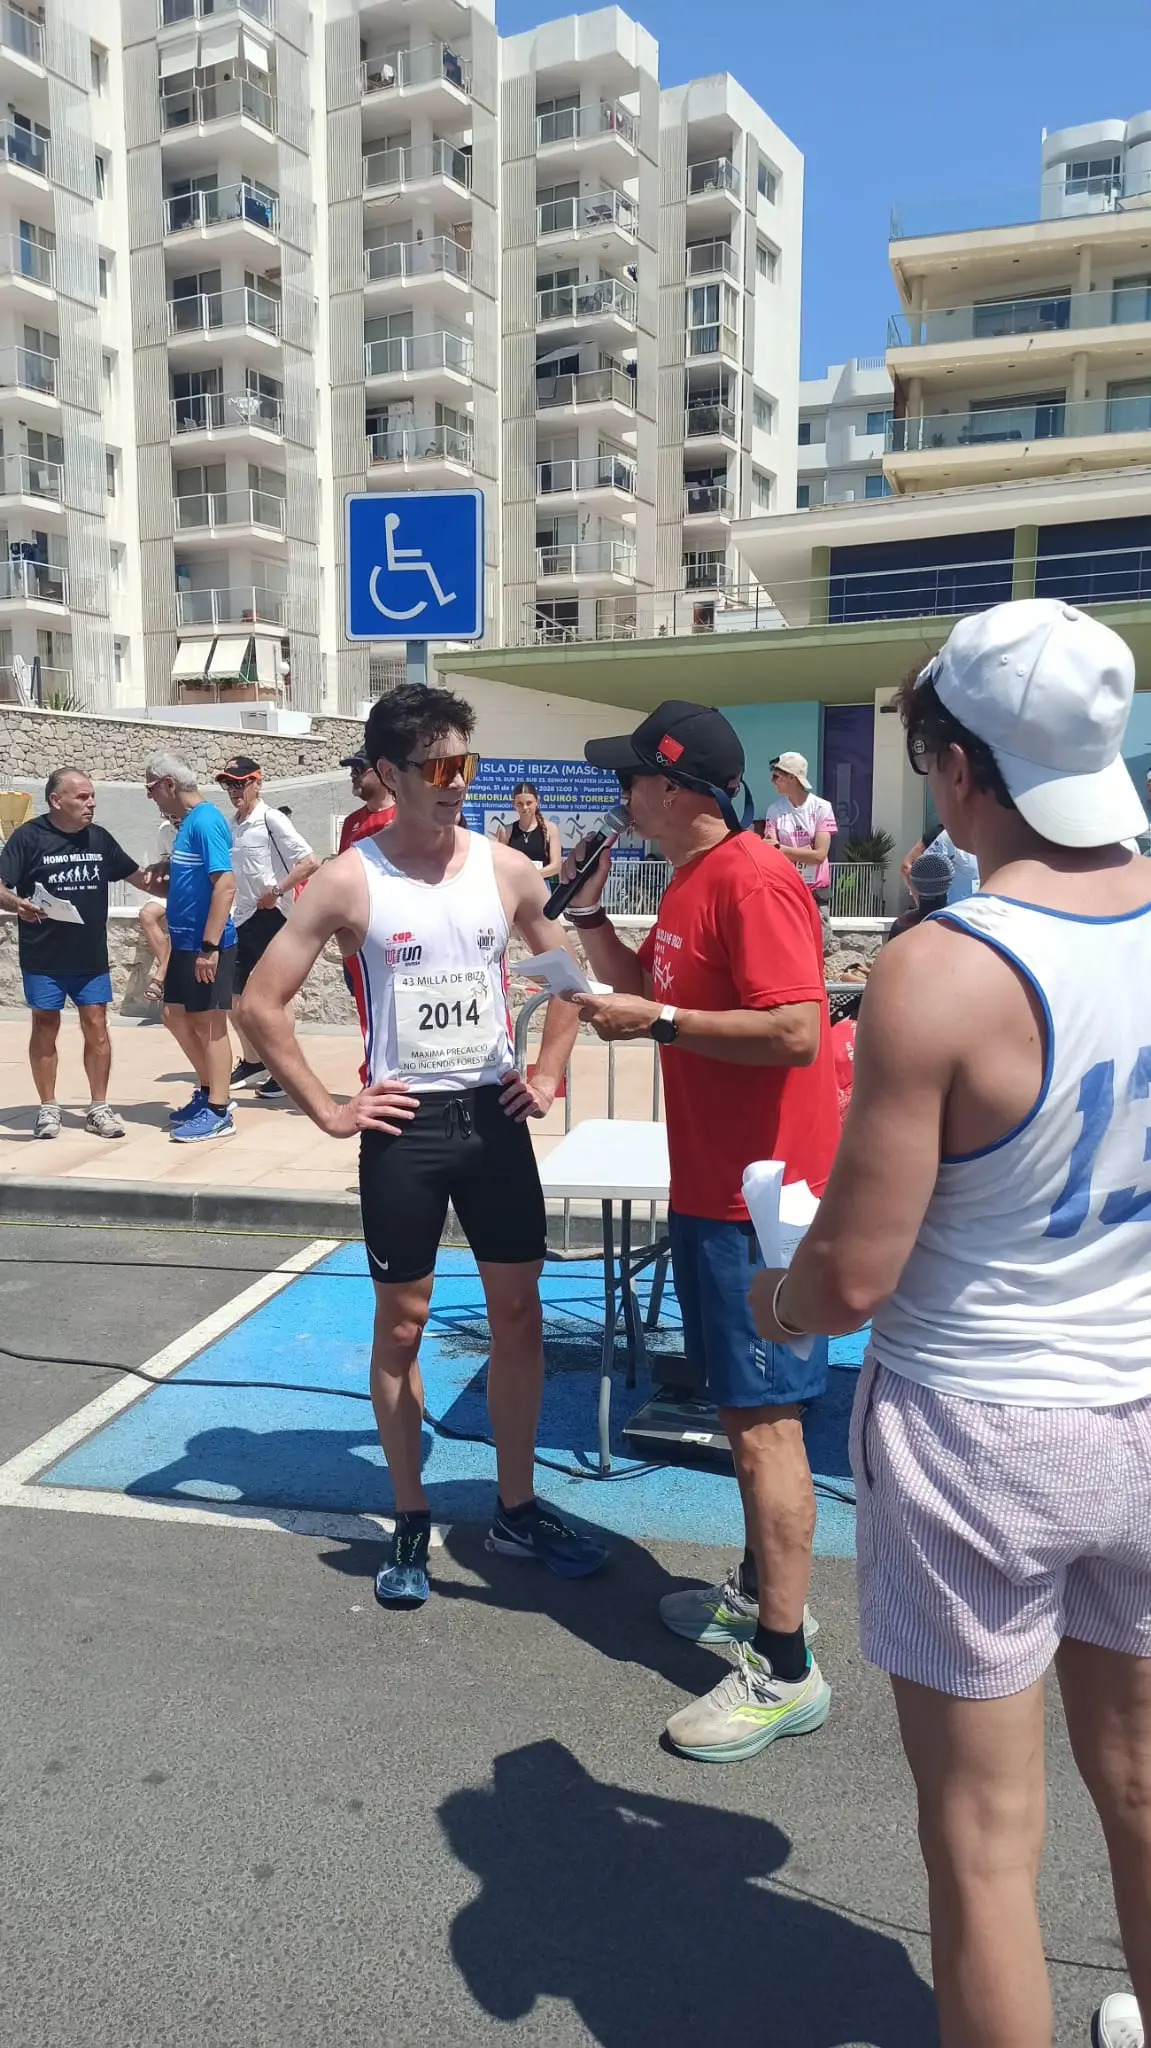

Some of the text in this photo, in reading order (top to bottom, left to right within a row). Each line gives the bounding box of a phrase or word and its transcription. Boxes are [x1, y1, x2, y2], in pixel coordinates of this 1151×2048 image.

[480, 763, 506, 773] ISLA
[509, 764, 525, 774] DE
[528, 764, 559, 775] IBIZA
[562, 765, 599, 776] (MASC
[465, 792, 514, 801] MEMORIAL
[543, 793, 578, 802] QUIRÓS
[43, 854, 69, 865] HOMO
[402, 971, 486, 986] 43 MILLA DE IBIZA
[418, 998, 480, 1031] 2014
[403, 1054, 496, 1070] NO INCENDIS FORESTALS
